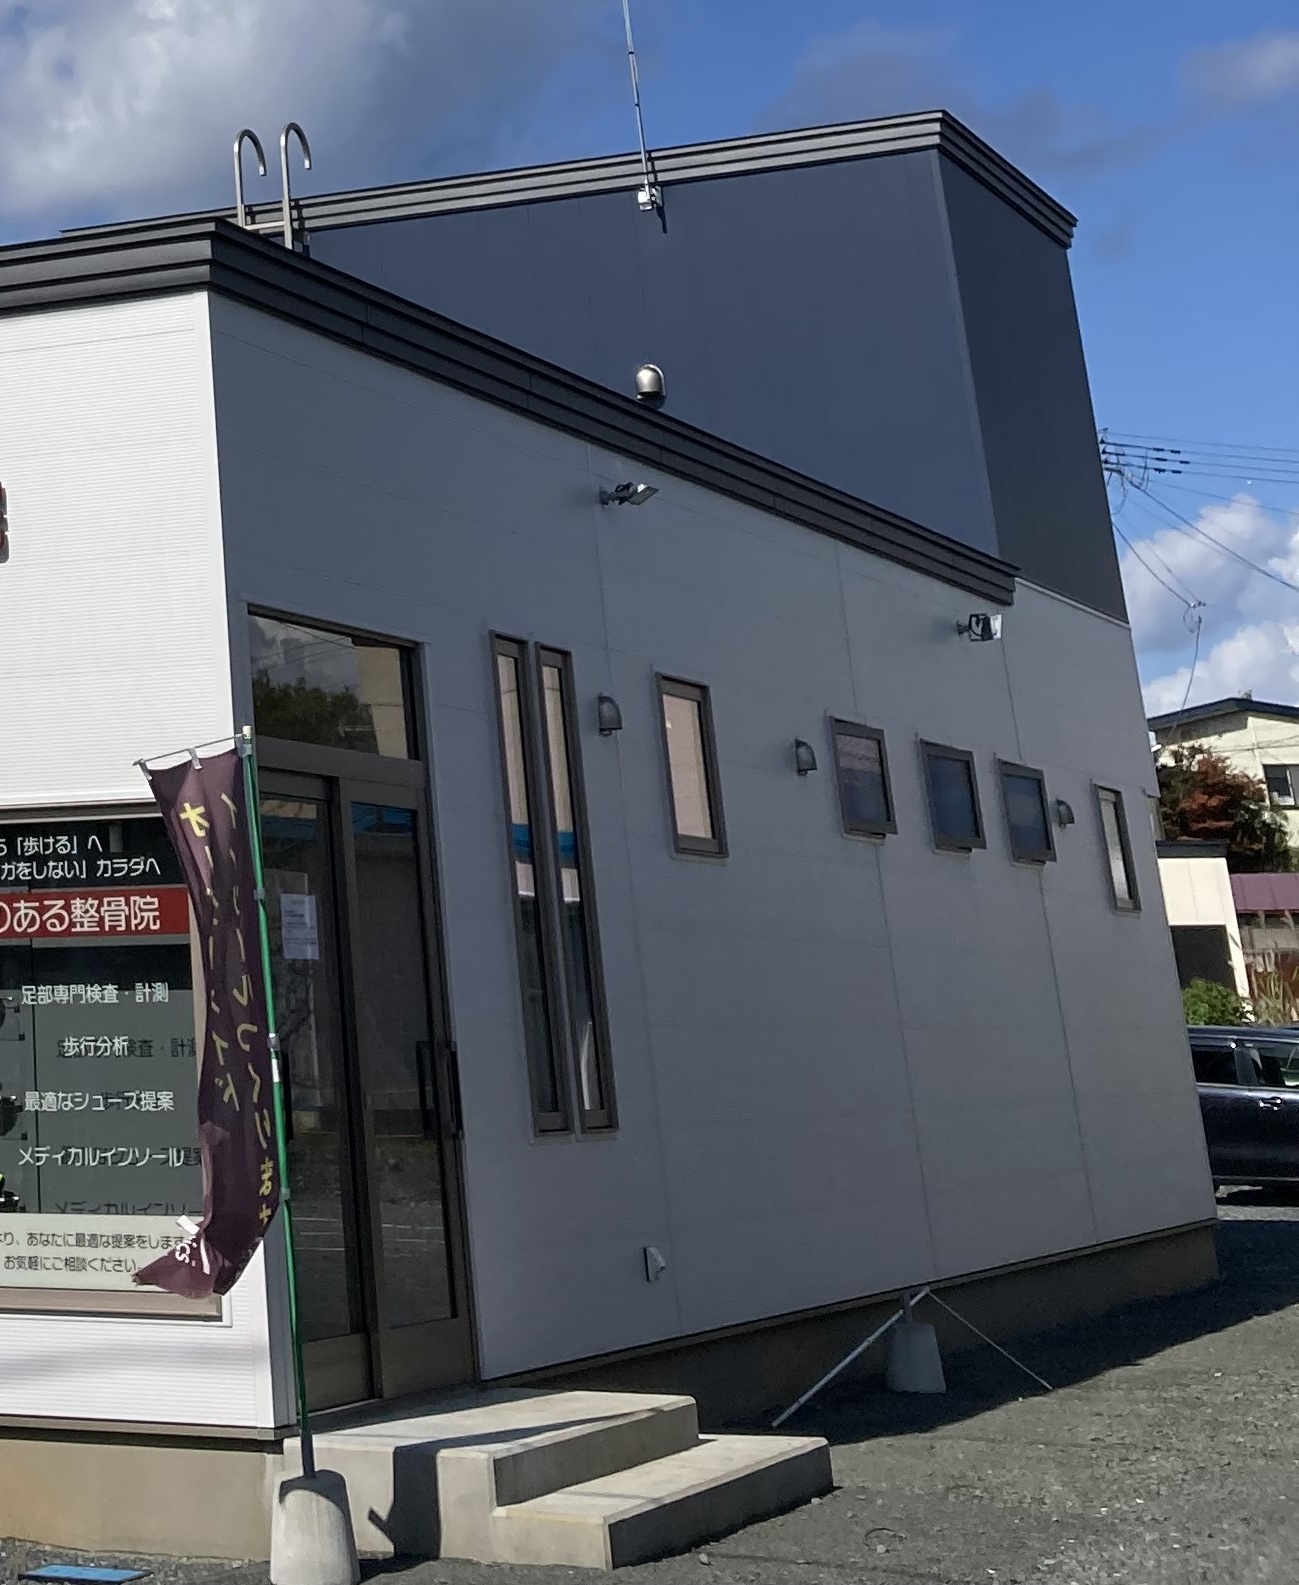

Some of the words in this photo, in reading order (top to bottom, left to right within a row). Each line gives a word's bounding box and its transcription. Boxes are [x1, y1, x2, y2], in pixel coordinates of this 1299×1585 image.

[21, 982, 169, 1005] 足部専門検査・計測
[63, 1036, 129, 1057] 歩行分析
[24, 1091, 175, 1112] 最適なシューズ提案
[18, 1146, 185, 1167] メディカルインソール
